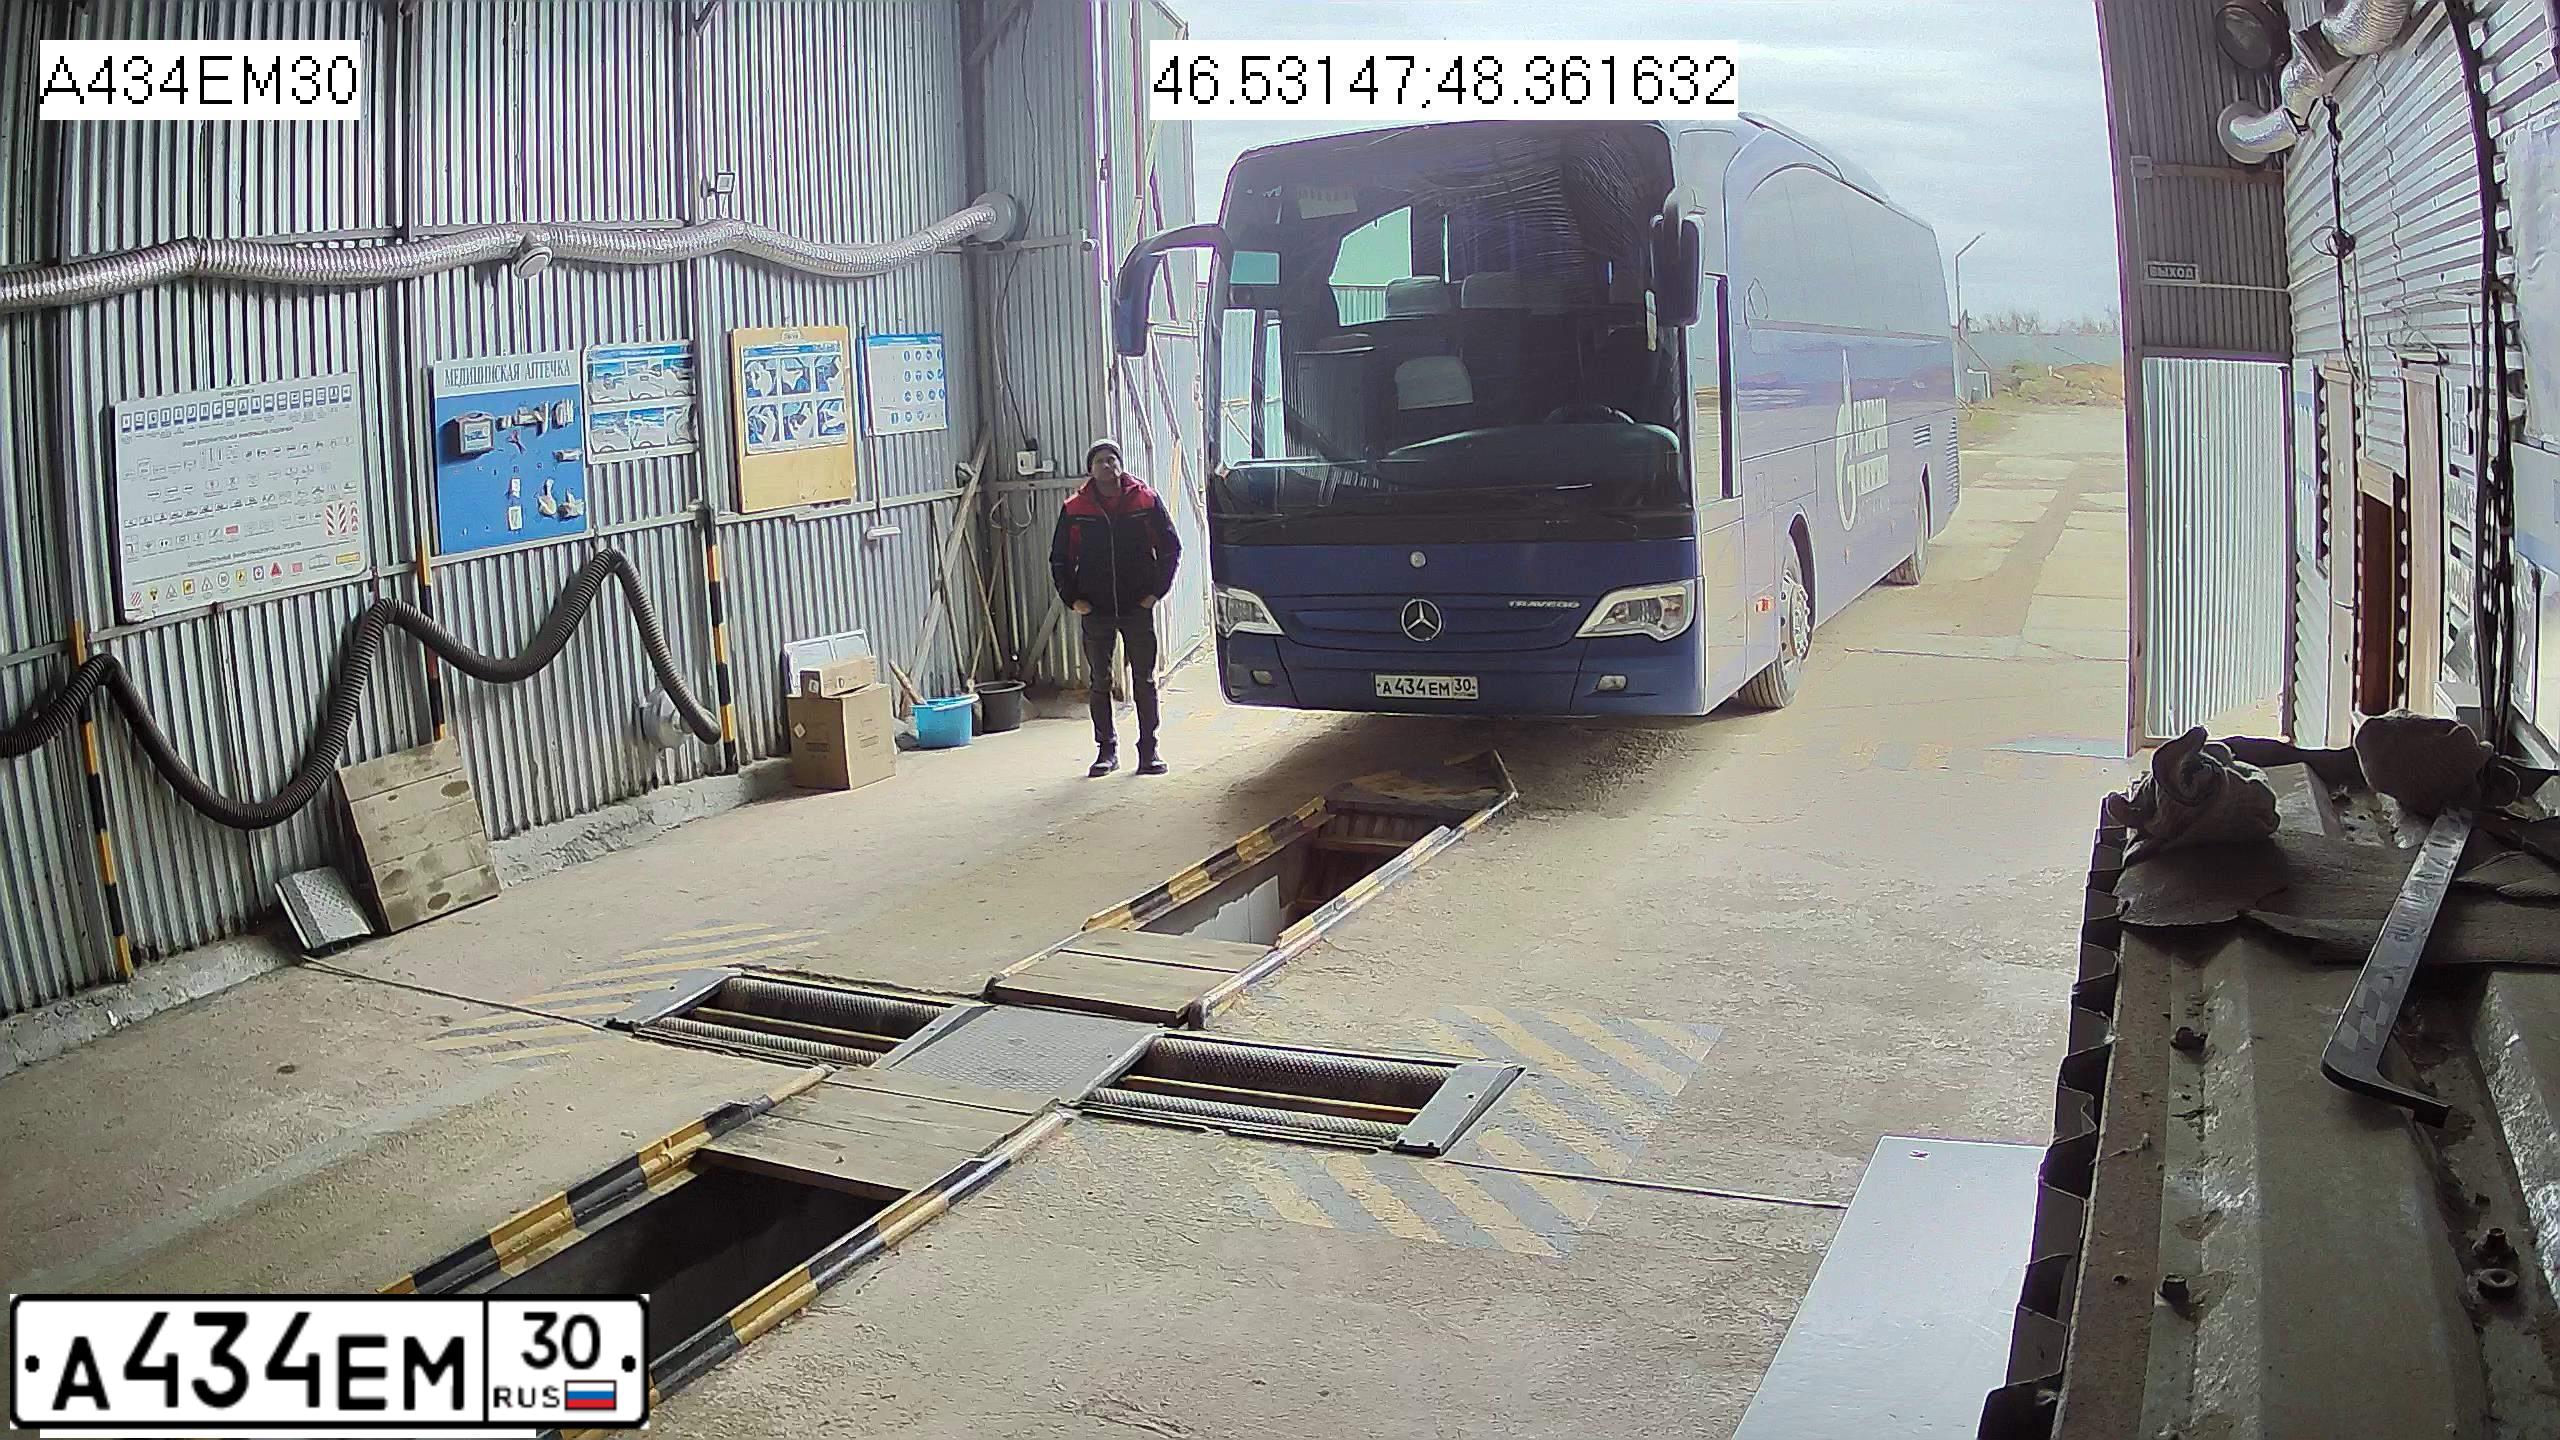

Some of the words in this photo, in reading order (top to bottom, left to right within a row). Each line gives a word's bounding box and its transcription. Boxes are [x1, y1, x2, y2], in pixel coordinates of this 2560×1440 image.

[2149, 265, 2194, 279] ВЫХОД
[444, 362, 520, 387] МЕДИЦИНСКАЯ
[524, 358, 571, 381] АПТЕЧКА
[1454, 678, 1471, 692] 30
